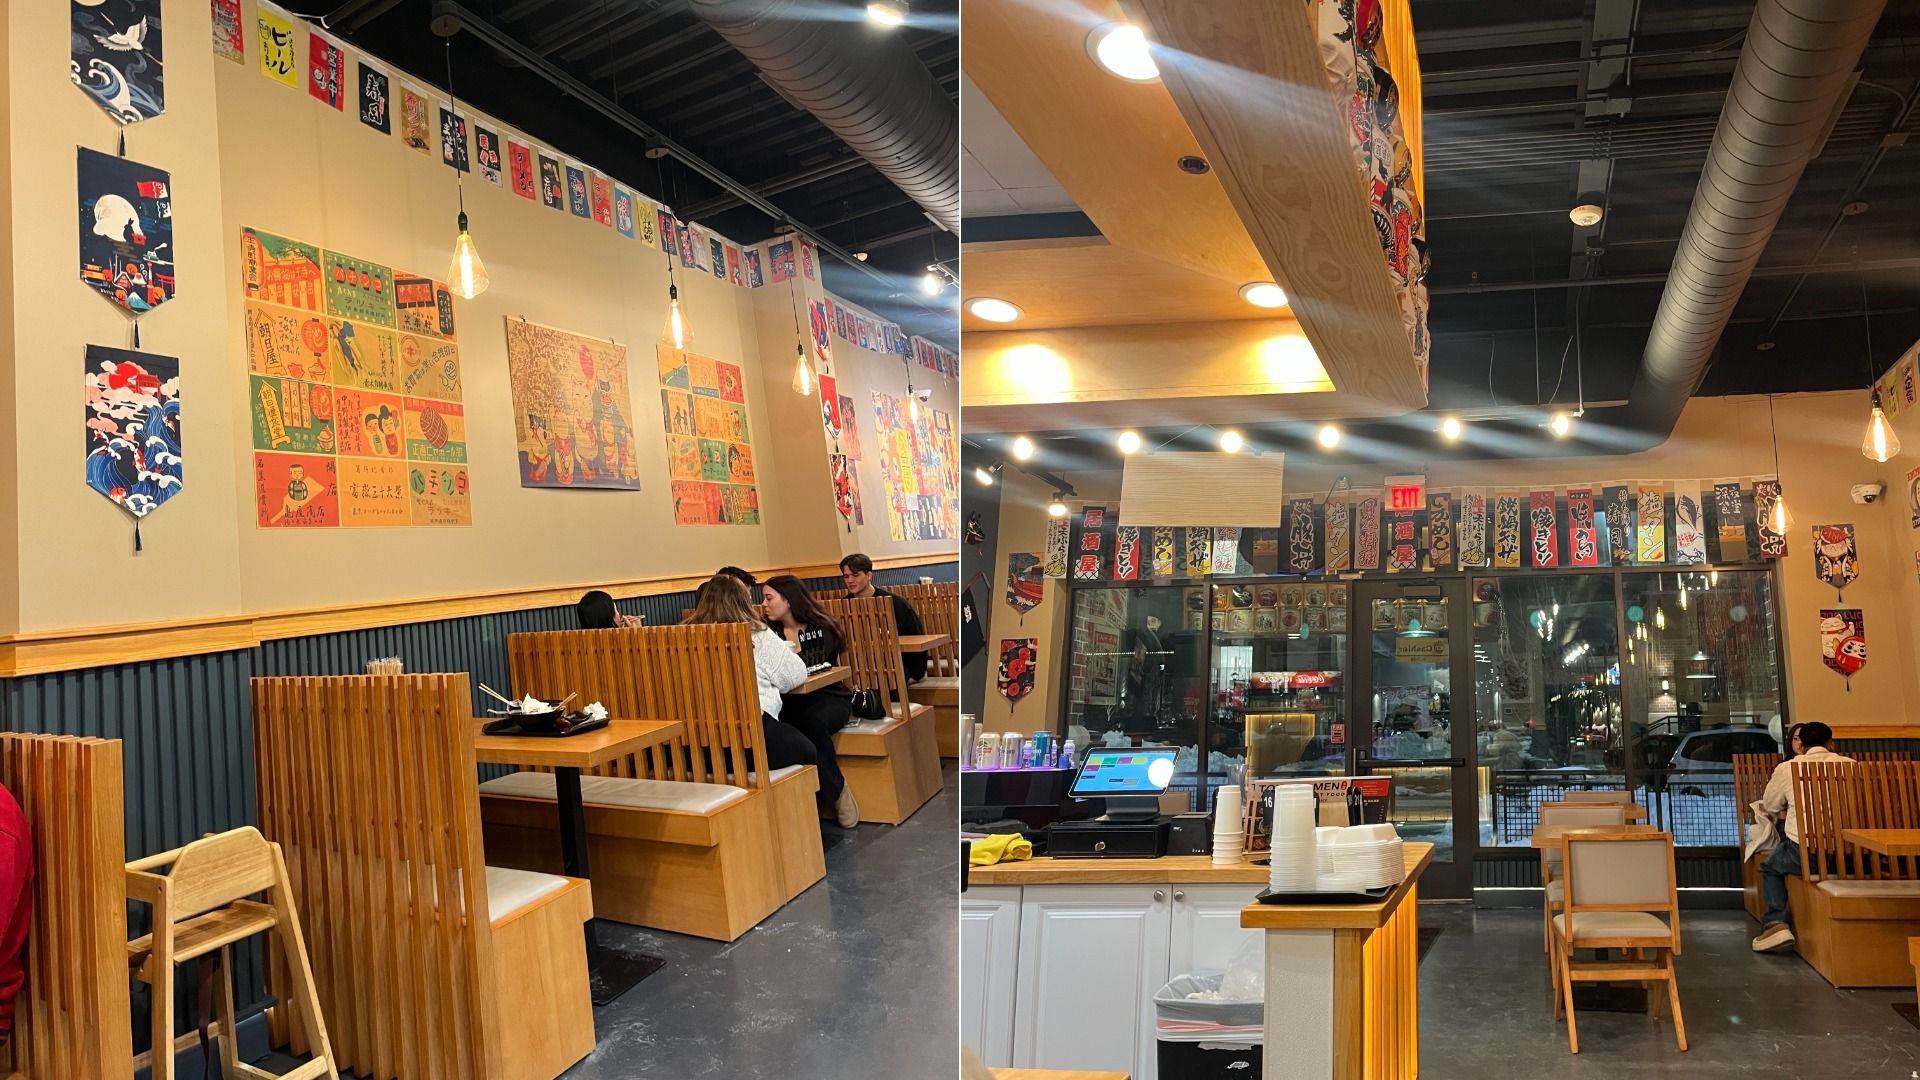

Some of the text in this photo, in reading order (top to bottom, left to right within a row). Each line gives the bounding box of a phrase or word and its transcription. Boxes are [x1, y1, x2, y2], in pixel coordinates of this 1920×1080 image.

[270, 26, 290, 75] ビール
[1391, 486, 1420, 508] EXIT
[1081, 510, 1103, 573] 居酒屋
[1531, 506, 1556, 566] 焼きとり
[1607, 502, 1623, 548] 寿司
[1639, 490, 1664, 560] 塩タン
[1263, 796, 1273, 808] 16
